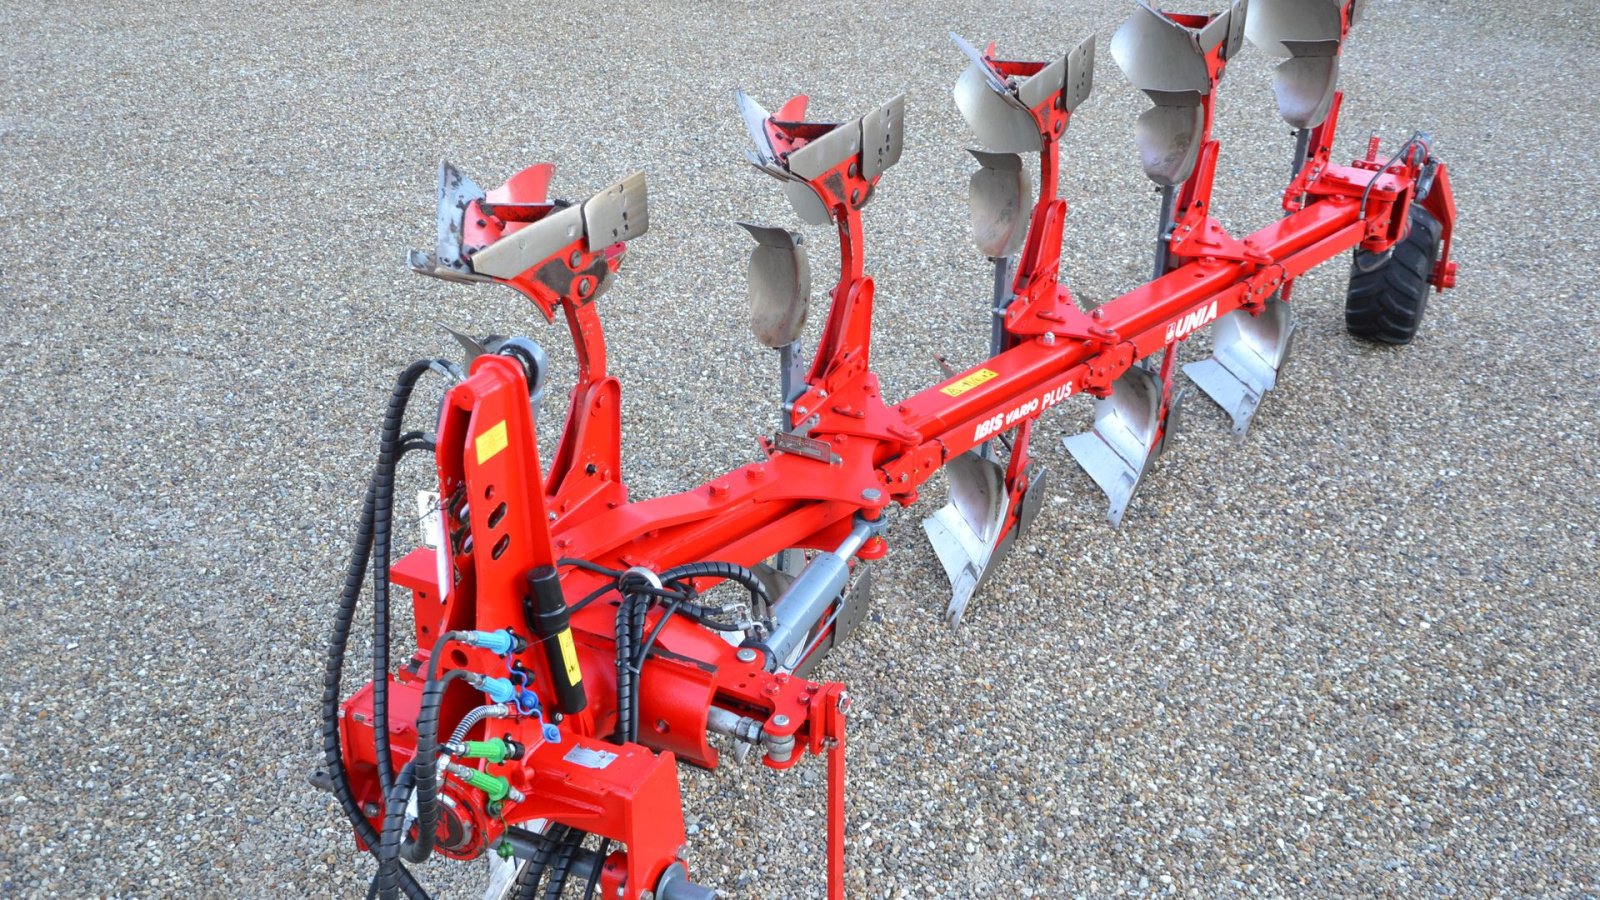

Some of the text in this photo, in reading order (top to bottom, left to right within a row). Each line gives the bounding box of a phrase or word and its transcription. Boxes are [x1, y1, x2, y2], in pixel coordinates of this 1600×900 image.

[1175, 299, 1218, 338] UNIA
[974, 381, 1073, 442] IBIS VARIO PLUS
